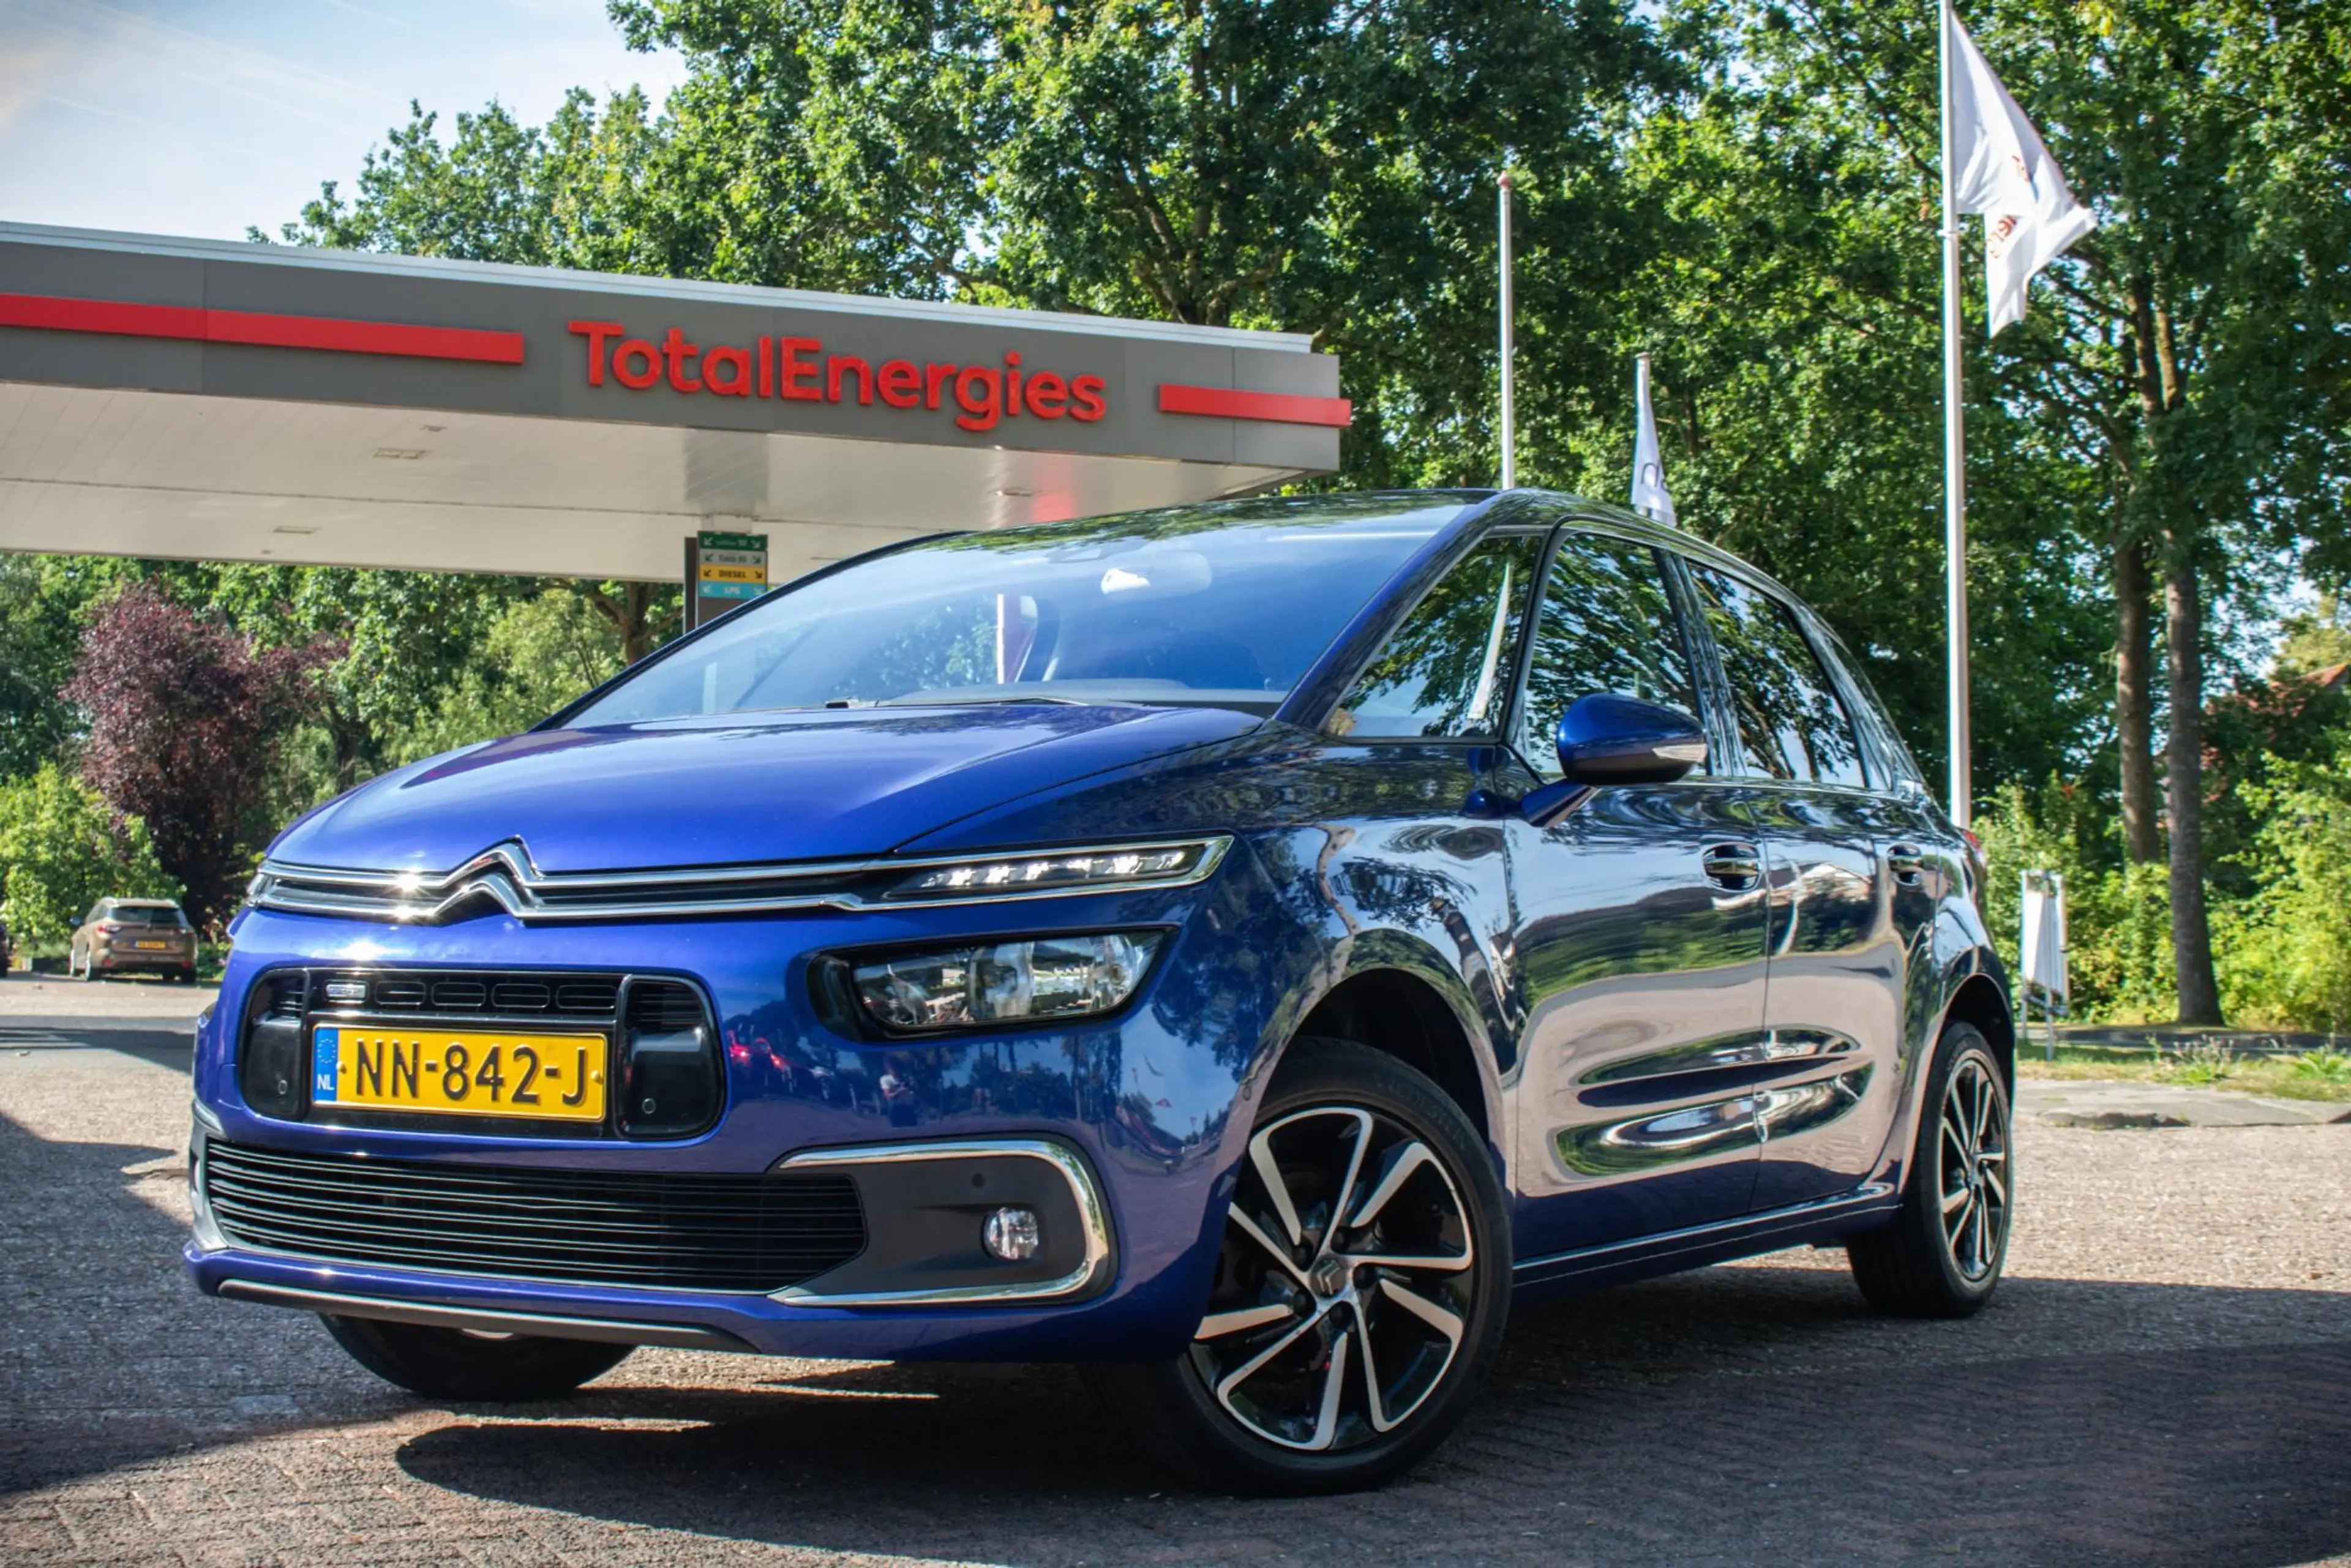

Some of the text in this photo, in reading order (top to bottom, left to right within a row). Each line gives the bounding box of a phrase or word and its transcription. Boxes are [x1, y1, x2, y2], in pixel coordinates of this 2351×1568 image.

[568, 320, 1106, 431] TotalEnergies
[719, 570, 747, 579] DIESEL
[317, 1075, 335, 1090] NL
[356, 1039, 586, 1106] NN-842-J
